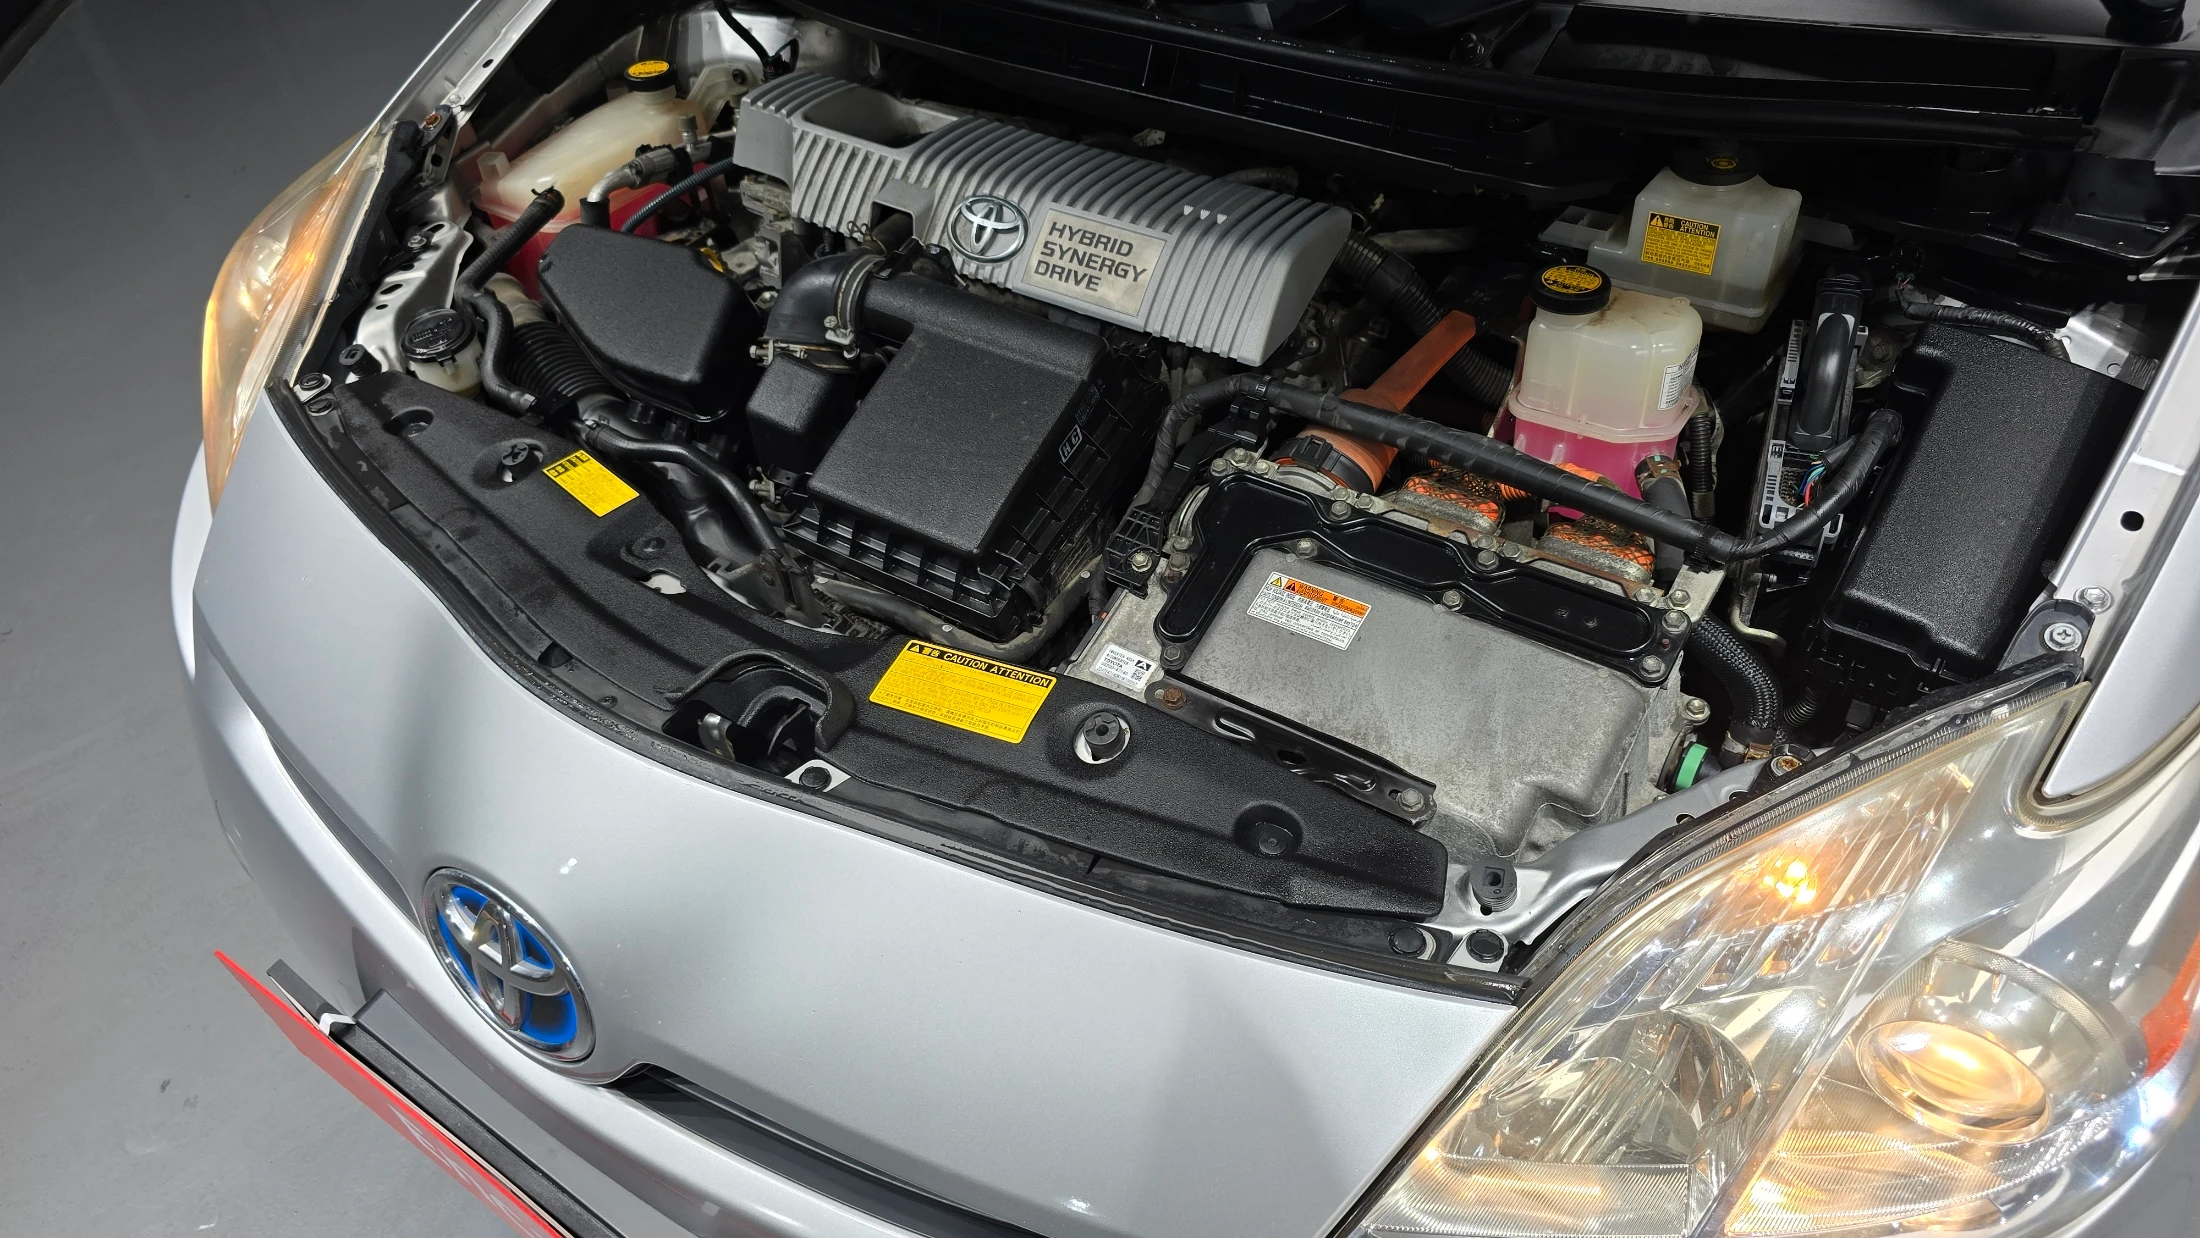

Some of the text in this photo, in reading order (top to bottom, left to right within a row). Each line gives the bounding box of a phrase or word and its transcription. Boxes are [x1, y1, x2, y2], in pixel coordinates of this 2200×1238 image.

[1049, 222, 1134, 257] HYBRID
[1680, 220, 1709, 231] CAUTION
[1680, 226, 1716, 238] ATTENTION
[1034, 259, 1102, 293] DRIVE
[1040, 240, 1149, 283] SYNERGY
[943, 653, 988, 671] CAUTION
[990, 664, 1050, 687] ATTENTION
[1103, 657, 1123, 669] TOYOTA
